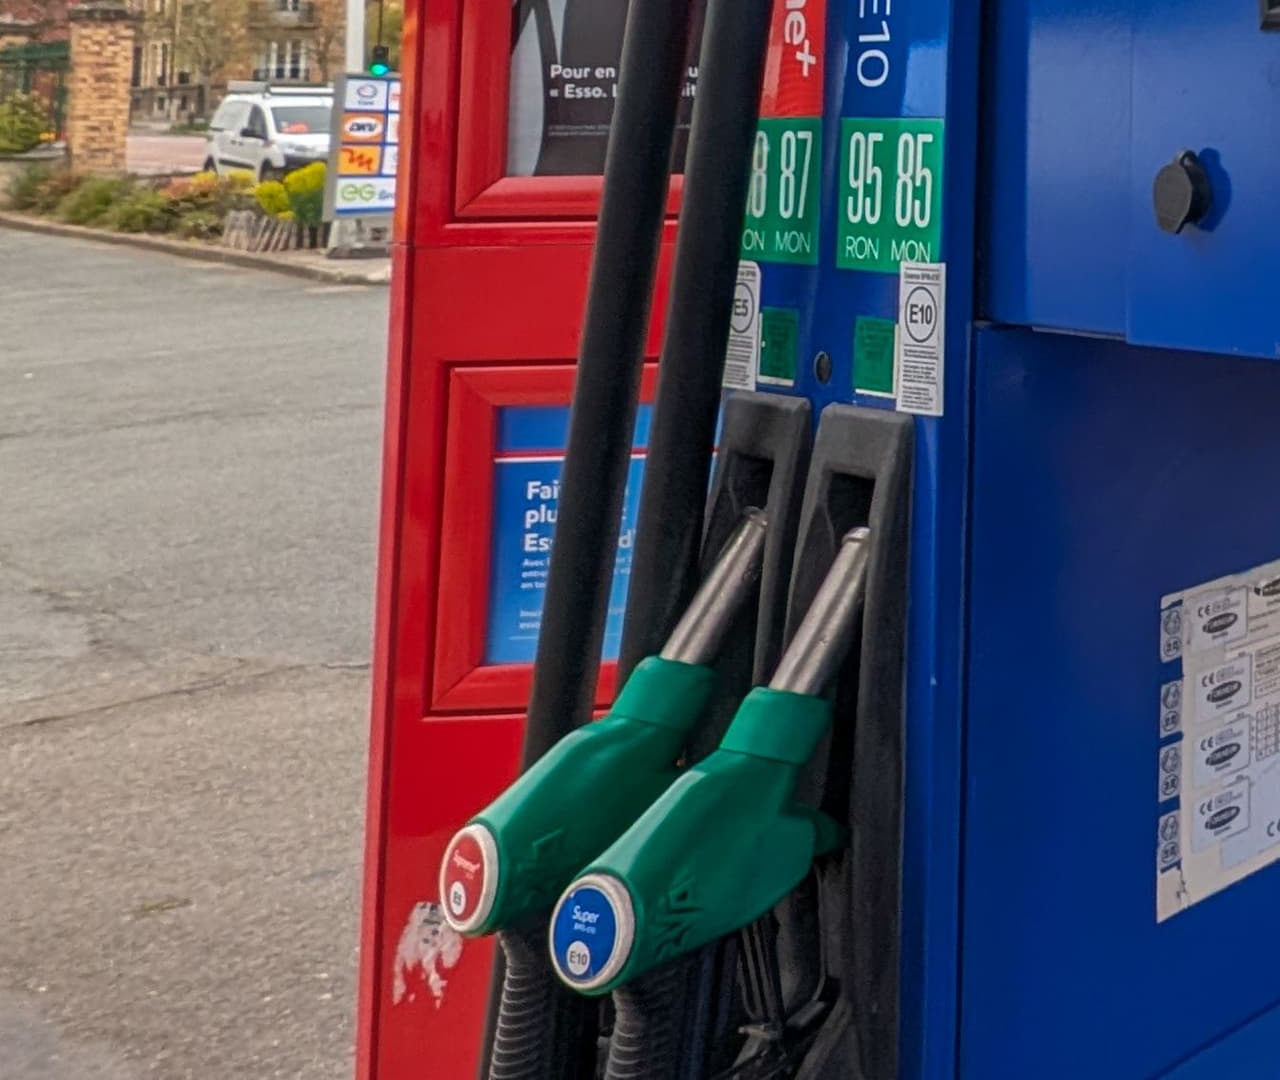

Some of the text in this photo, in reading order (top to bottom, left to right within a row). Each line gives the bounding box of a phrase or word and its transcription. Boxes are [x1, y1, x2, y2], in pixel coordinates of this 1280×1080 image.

[550, 64, 616, 79] Pour en
[564, 83, 607, 98] Esso.
[779, 130, 813, 219] 87
[847, 131, 884, 225] 95
[895, 132, 933, 228] 85
[742, 229, 931, 264] ON MON RON MON
[909, 303, 933, 325] E10
[572, 905, 600, 924] Super
[569, 949, 589, 967] E10
